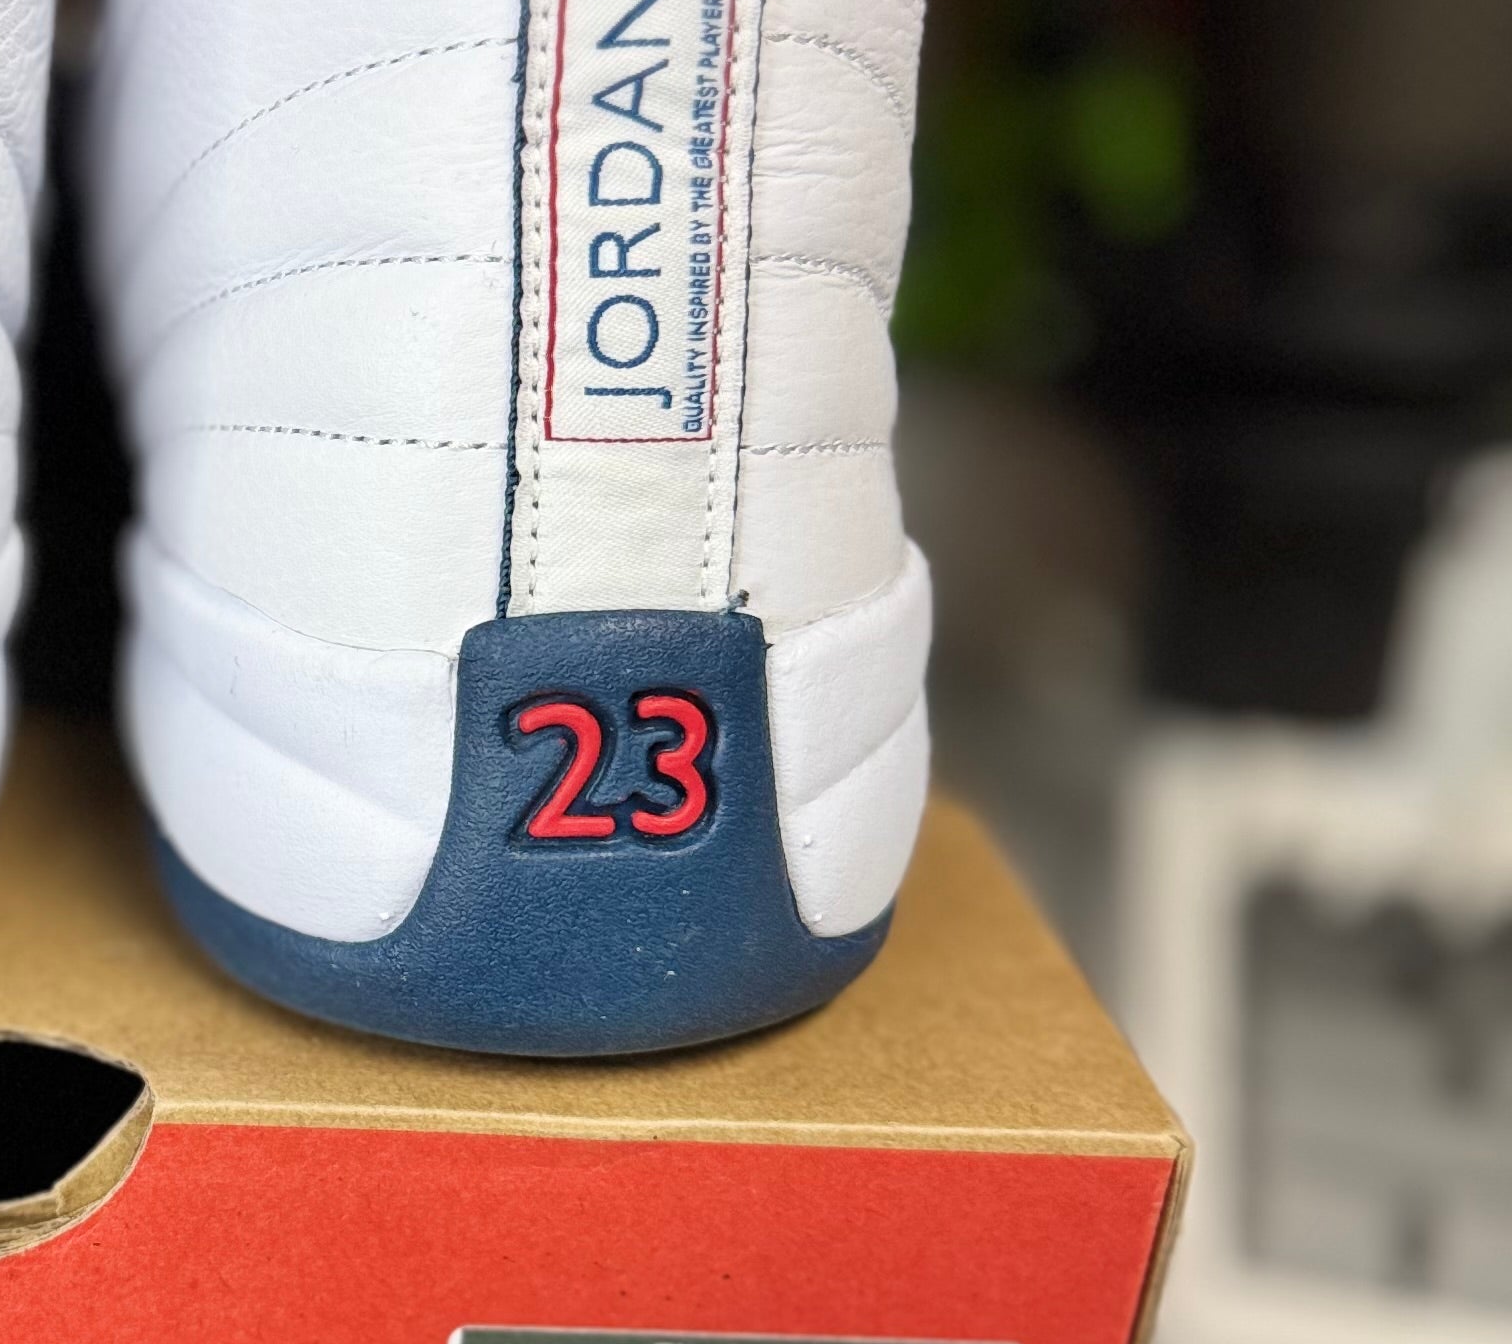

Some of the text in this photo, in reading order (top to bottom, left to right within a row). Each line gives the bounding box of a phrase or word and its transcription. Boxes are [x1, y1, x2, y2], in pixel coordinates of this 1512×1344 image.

[689, 74, 719, 169] GREATEST
[689, 219, 712, 245] BY
[690, 176, 714, 212] THE
[687, 252, 711, 340] INSPIRED
[682, 348, 706, 432] QUALITY
[516, 694, 709, 839] 23
